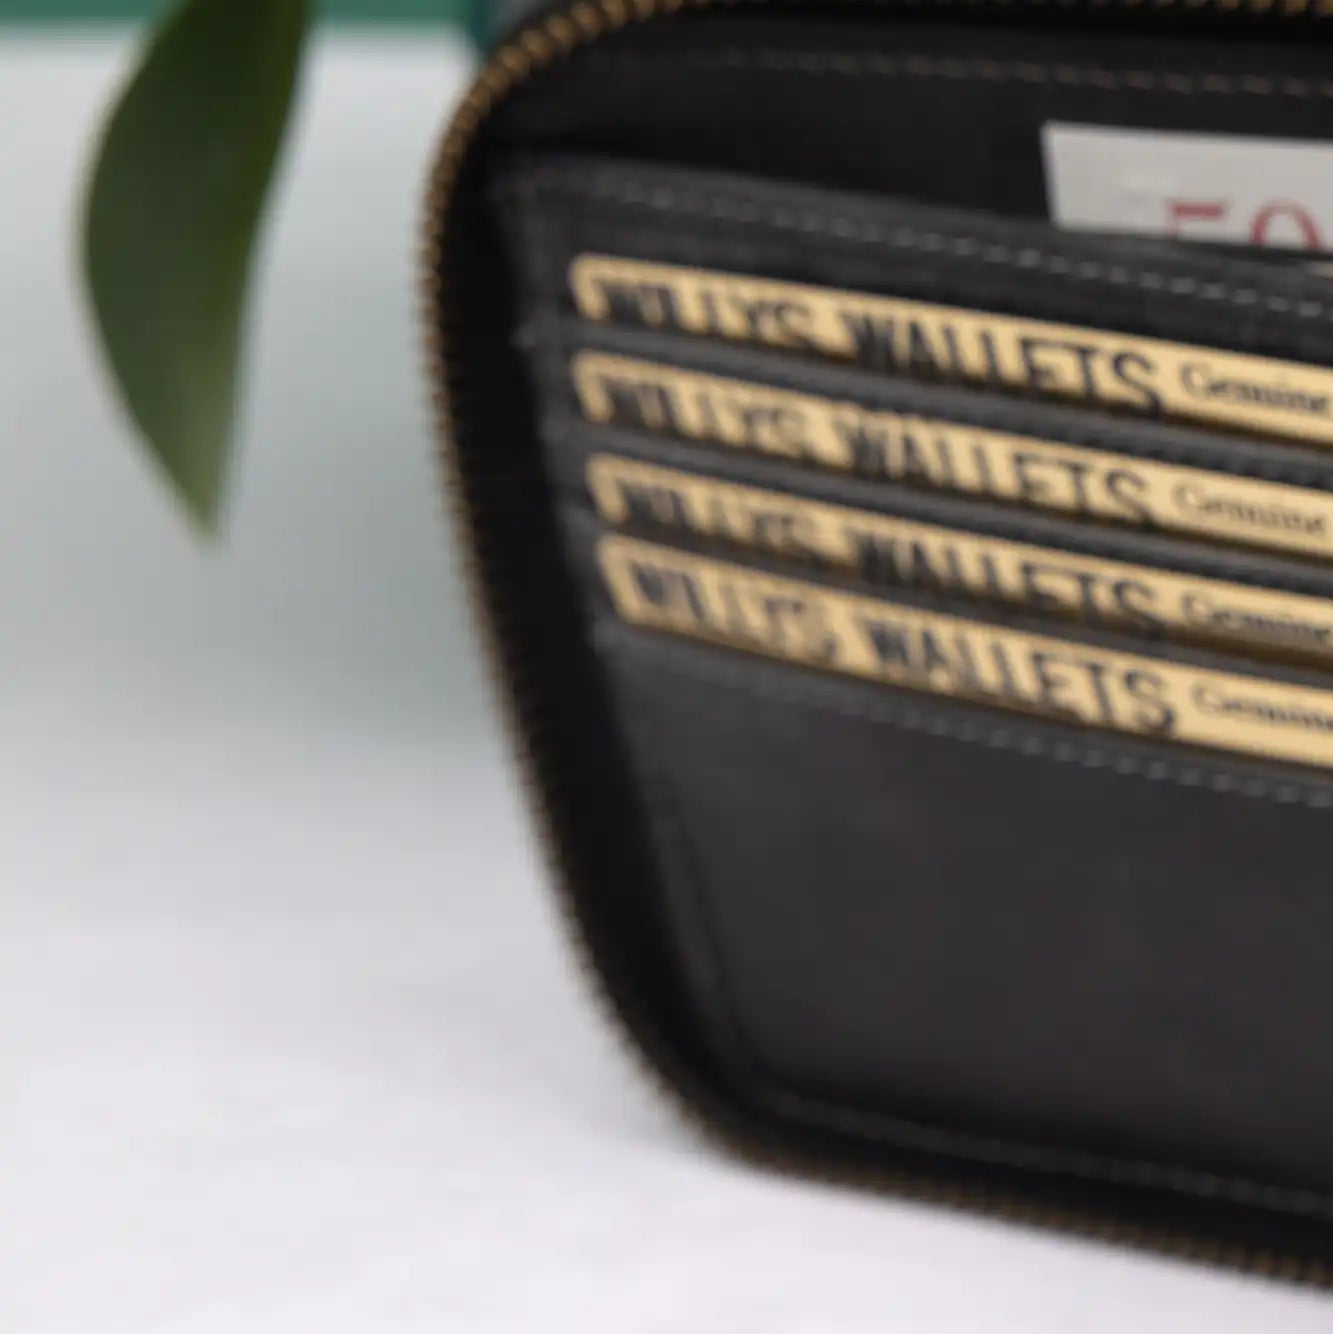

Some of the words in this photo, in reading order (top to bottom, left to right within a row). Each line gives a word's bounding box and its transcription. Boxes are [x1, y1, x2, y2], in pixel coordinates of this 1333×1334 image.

[848, 312, 1163, 416] WALLETS
[1180, 362, 1331, 414] Genuine
[842, 411, 1156, 525] WALLETS
[1172, 484, 1327, 533] Genuine
[856, 527, 1166, 638] WALLETS
[865, 616, 1176, 738] WALLETS
